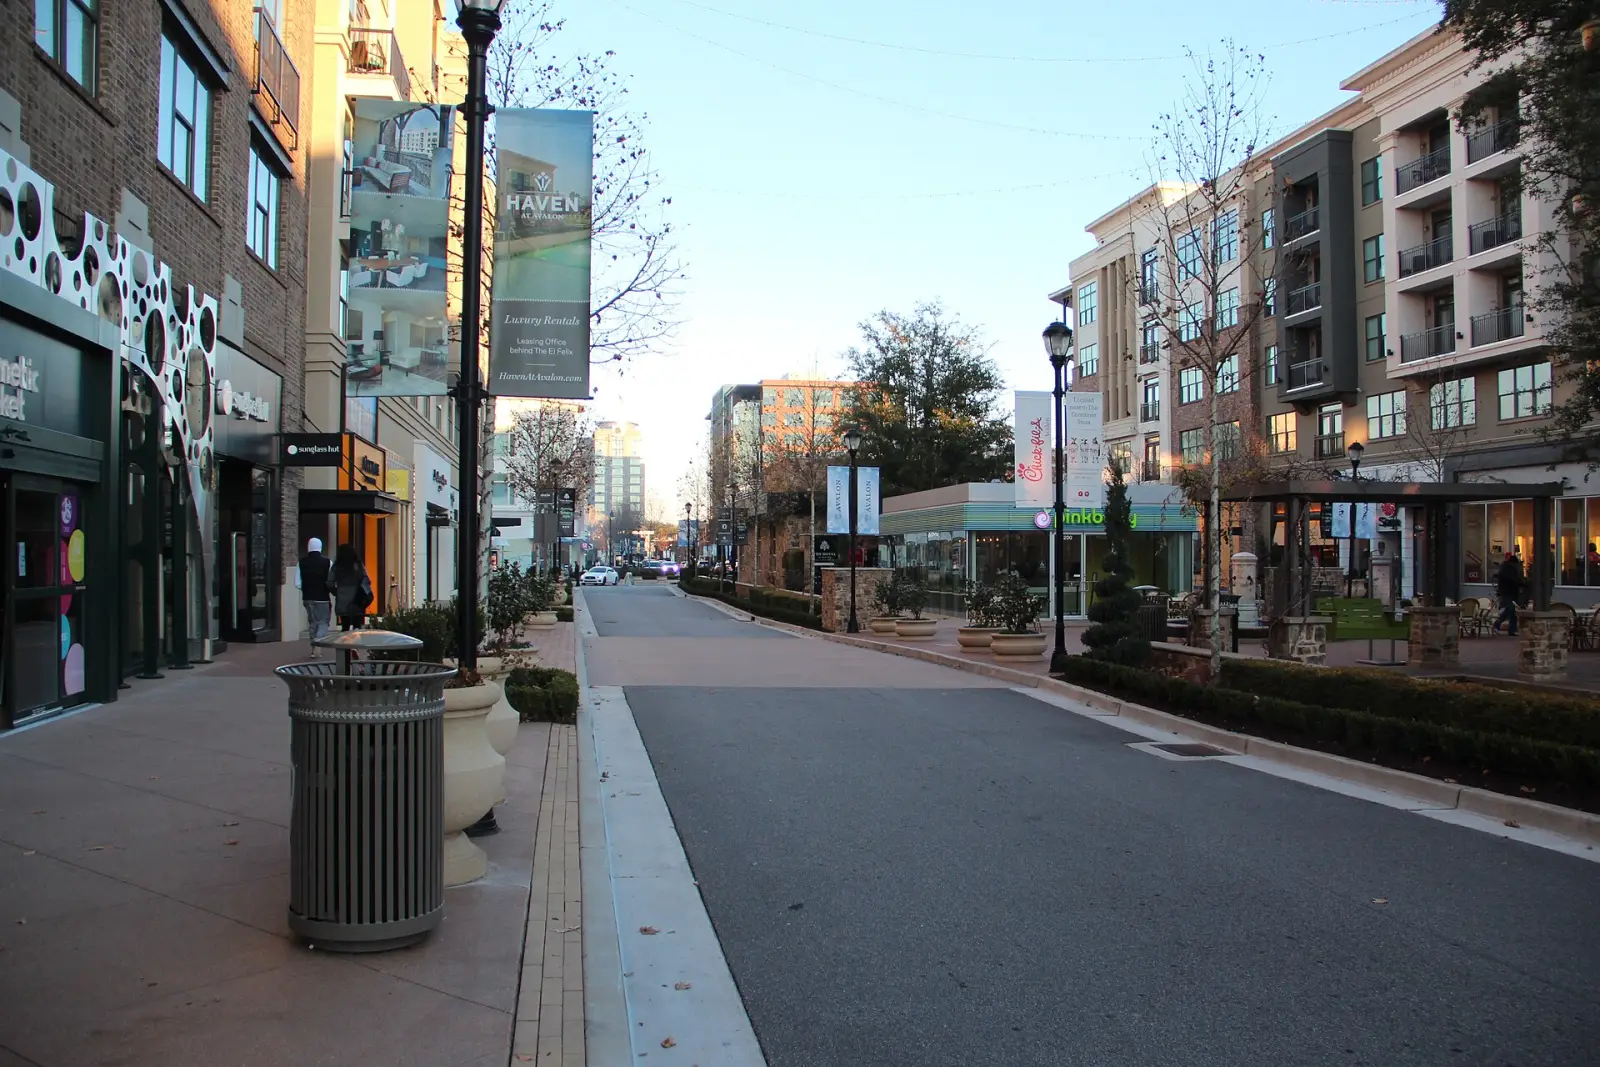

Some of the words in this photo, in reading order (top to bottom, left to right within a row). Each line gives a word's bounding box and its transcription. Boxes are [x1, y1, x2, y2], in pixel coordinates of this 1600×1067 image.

[507, 195, 579, 212] HAVEN
[504, 314, 541, 327] Luxury
[544, 315, 580, 326] Rentals
[517, 337, 543, 346] Leasing
[545, 338, 567, 346] Office
[509, 347, 533, 355] behind
[535, 347, 547, 355] The
[548, 347, 556, 355] El
[557, 348, 573, 356] Felix
[498, 372, 582, 382] HavenAtAvalon.com
[298, 445, 327, 454] sunglass
[328, 445, 340, 453] hut
[1022, 417, 1045, 482] Chick-fil-A
